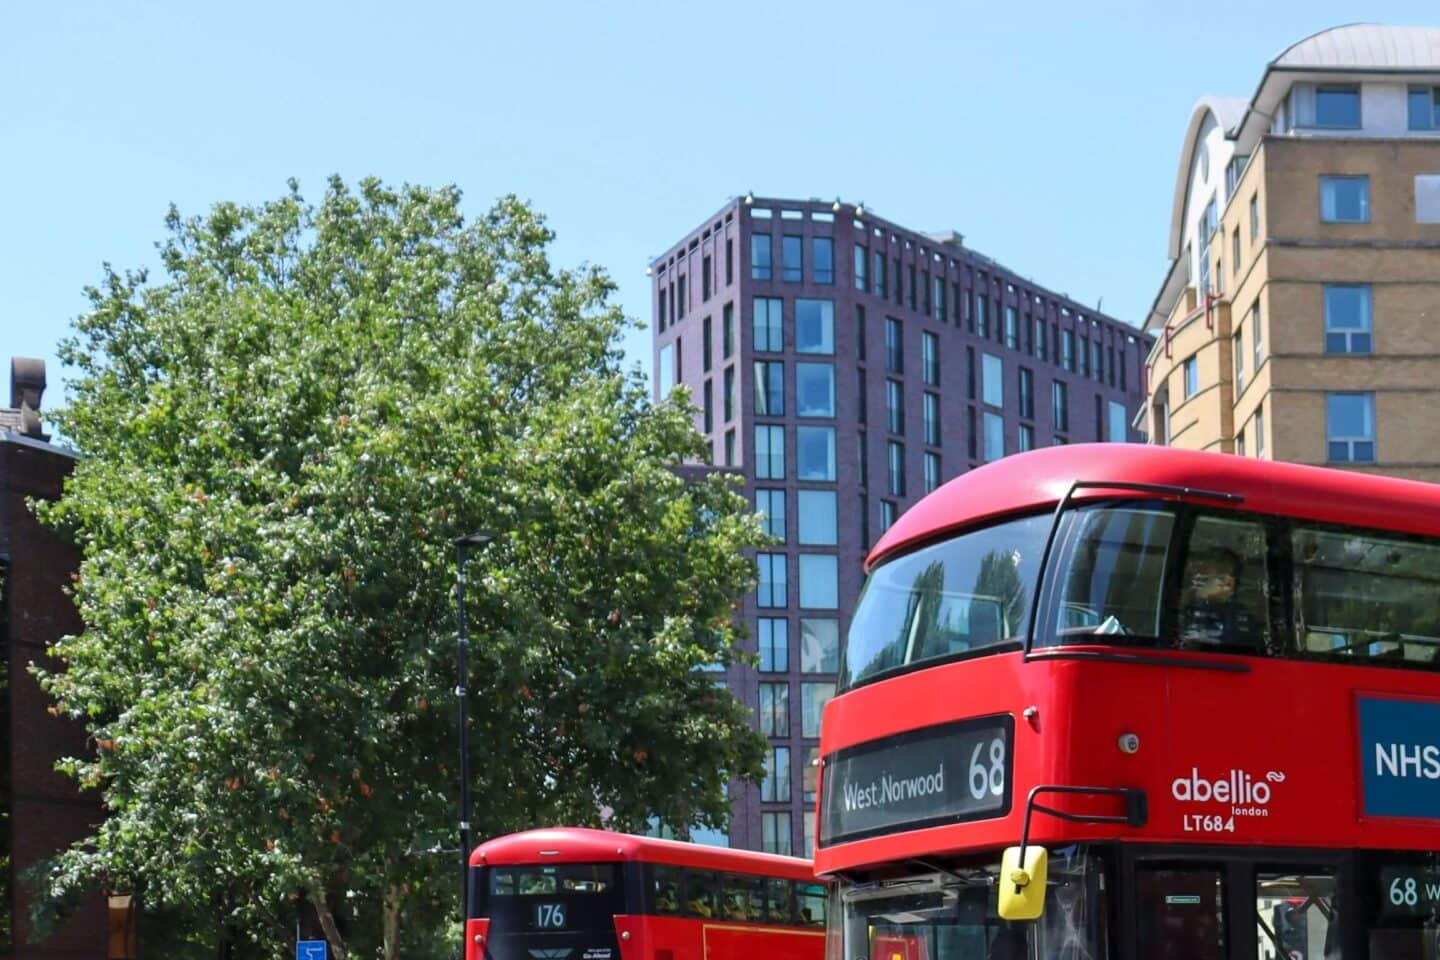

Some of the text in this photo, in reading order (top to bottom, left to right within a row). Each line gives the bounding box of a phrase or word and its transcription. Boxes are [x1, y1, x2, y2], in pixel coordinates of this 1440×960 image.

[843, 738, 1005, 811] West Norwood 68
[1172, 767, 1271, 804] abellio
[1183, 815, 1235, 832] LT684
[1231, 806, 1269, 816] london
[1390, 878, 1418, 906] 68
[538, 904, 564, 927] 176
